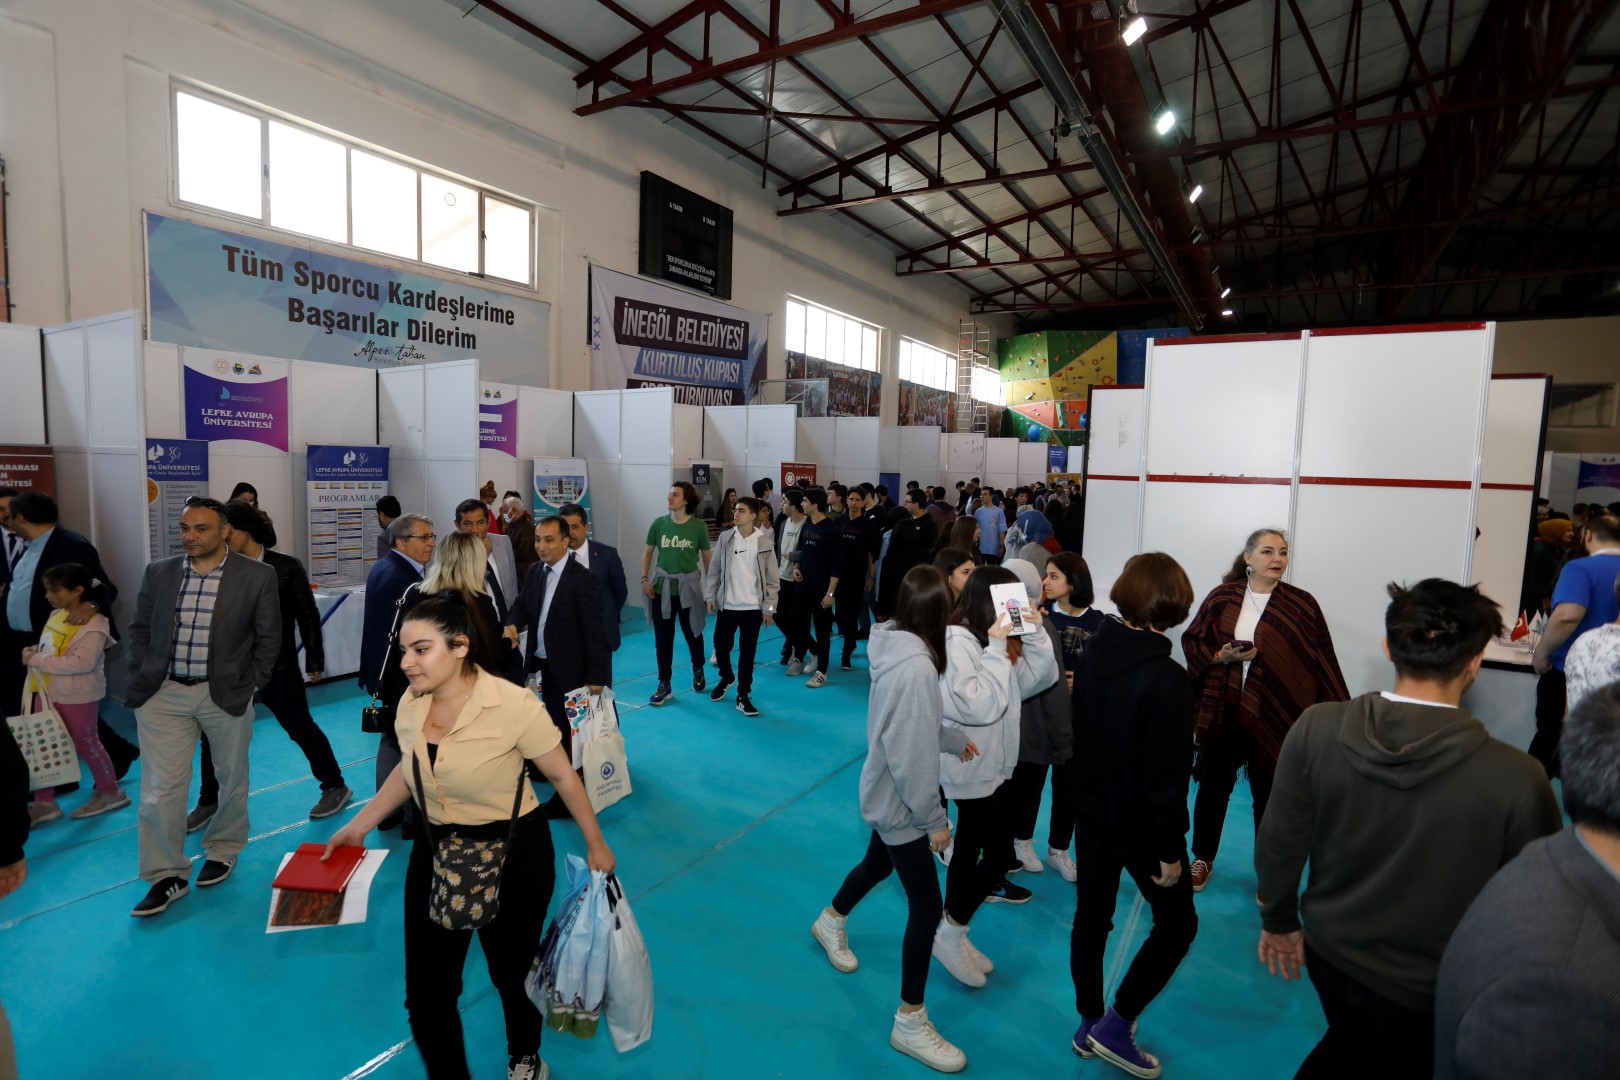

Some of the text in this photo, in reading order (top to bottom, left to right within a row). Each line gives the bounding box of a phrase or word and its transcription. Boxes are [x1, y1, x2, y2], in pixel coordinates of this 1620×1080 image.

[222, 244, 515, 325] Tüm Sporcu Kardeşlerime
[288, 297, 477, 349] Başarılar Dilerim
[621, 302, 744, 351] İNEGÖL BELEDİYESİ
[641, 350, 740, 384] KURTULUŞ KUPASI
[201, 408, 274, 420] LEFKE AVRUPA
[203, 417, 272, 429] ÜNİVERSİTESİ
[0, 479, 32, 487] RSİTESİ
[318, 494, 380, 502] PROGRAMLAR
